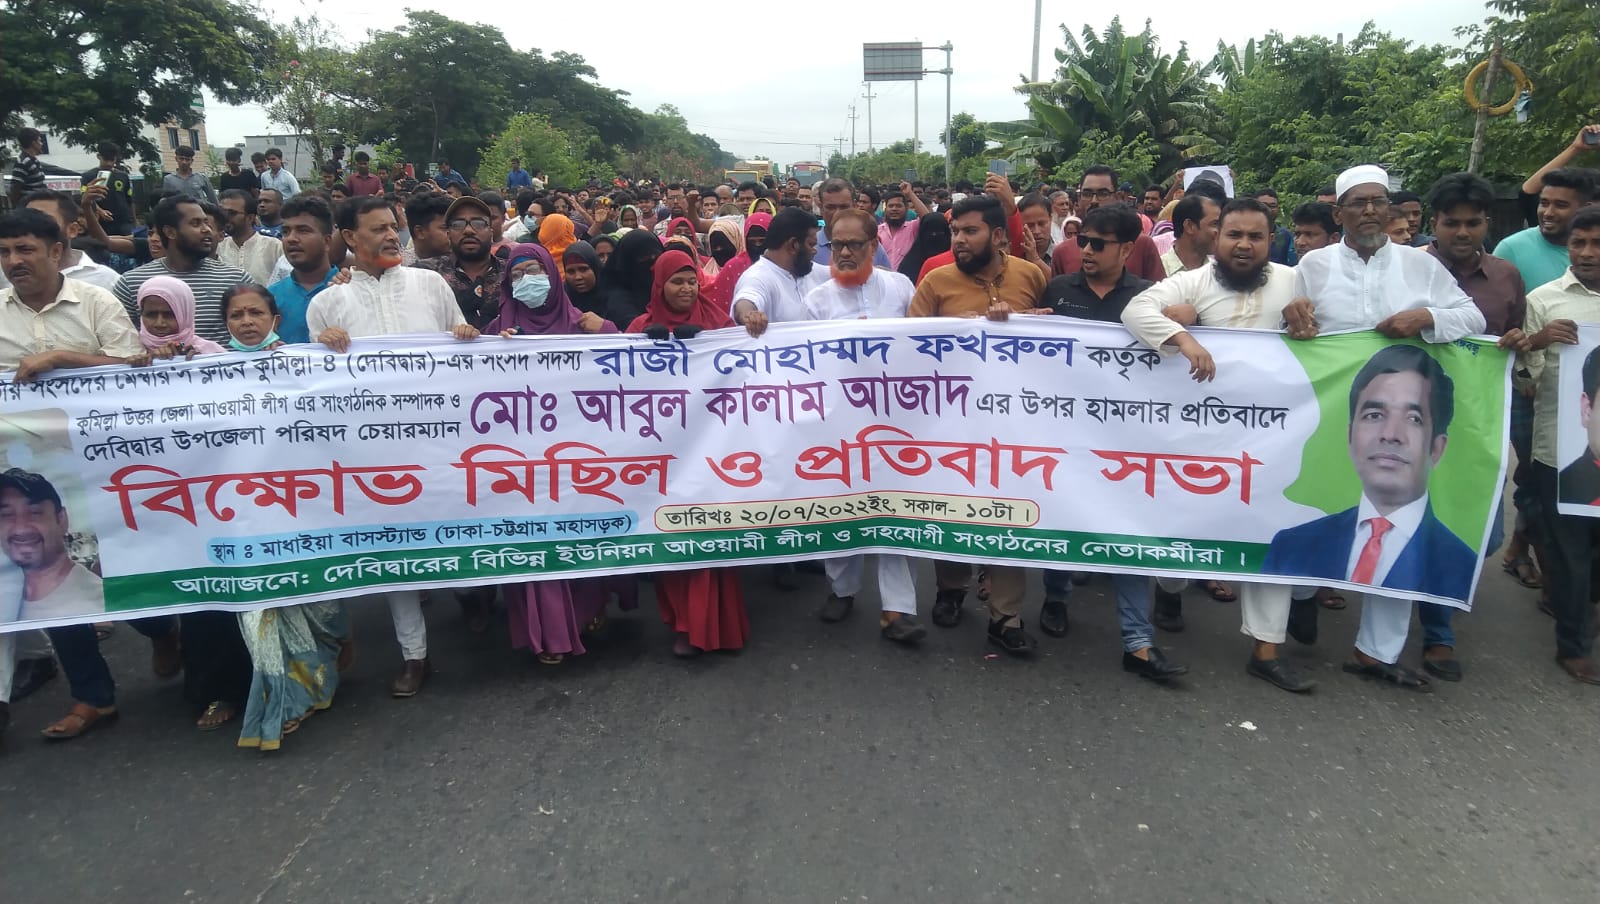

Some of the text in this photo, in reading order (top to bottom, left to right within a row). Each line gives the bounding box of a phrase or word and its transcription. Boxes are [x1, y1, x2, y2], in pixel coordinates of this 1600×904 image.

[253, 349, 336, 383] কুমিল্লা-৪
[537, 349, 584, 372] সদস্য
[590, 340, 694, 378] রাজী
[713, 336, 897, 375] মোহাম্মদ
[909, 330, 1080, 367] ফখরুল
[1085, 340, 1162, 382] কর্তৃক
[76, 386, 461, 437] কুমিল্লা উত্তর জেলা আওয়ামী লীগ এর সাংগঠনিক সম্পাদক ও
[470, 369, 1290, 442] মোঃ আবুল কালাম আজাদ এর উপর হামলার প্রতিবাদে
[83, 419, 462, 462] দেবিদ্বার উপজেলা পরিষদ চেয়ারম্যান
[101, 423, 1266, 532] বিক্ষোভ মিছিল ও প্রতিবাদ সভা
[966, 499, 1017, 522] ১০টা
[211, 542, 237, 563] স্থান
[259, 533, 335, 559] মাধাইয়া
[553, 512, 633, 538] মহাসড়ক)
[322, 552, 461, 584] দেবিদ্বারের
[468, 549, 546, 572] বিভিন্ন
[556, 540, 657, 564] ইউনিয়ন
[663, 533, 768, 556] আওয়ামী
[774, 529, 824, 549] লীগ
[831, 530, 851, 545] ও
[860, 524, 944, 547] সহযোগী
[952, 528, 1070, 556] সংগঠনের
[1080, 538, 1226, 567] নেতাকর্মীরা
